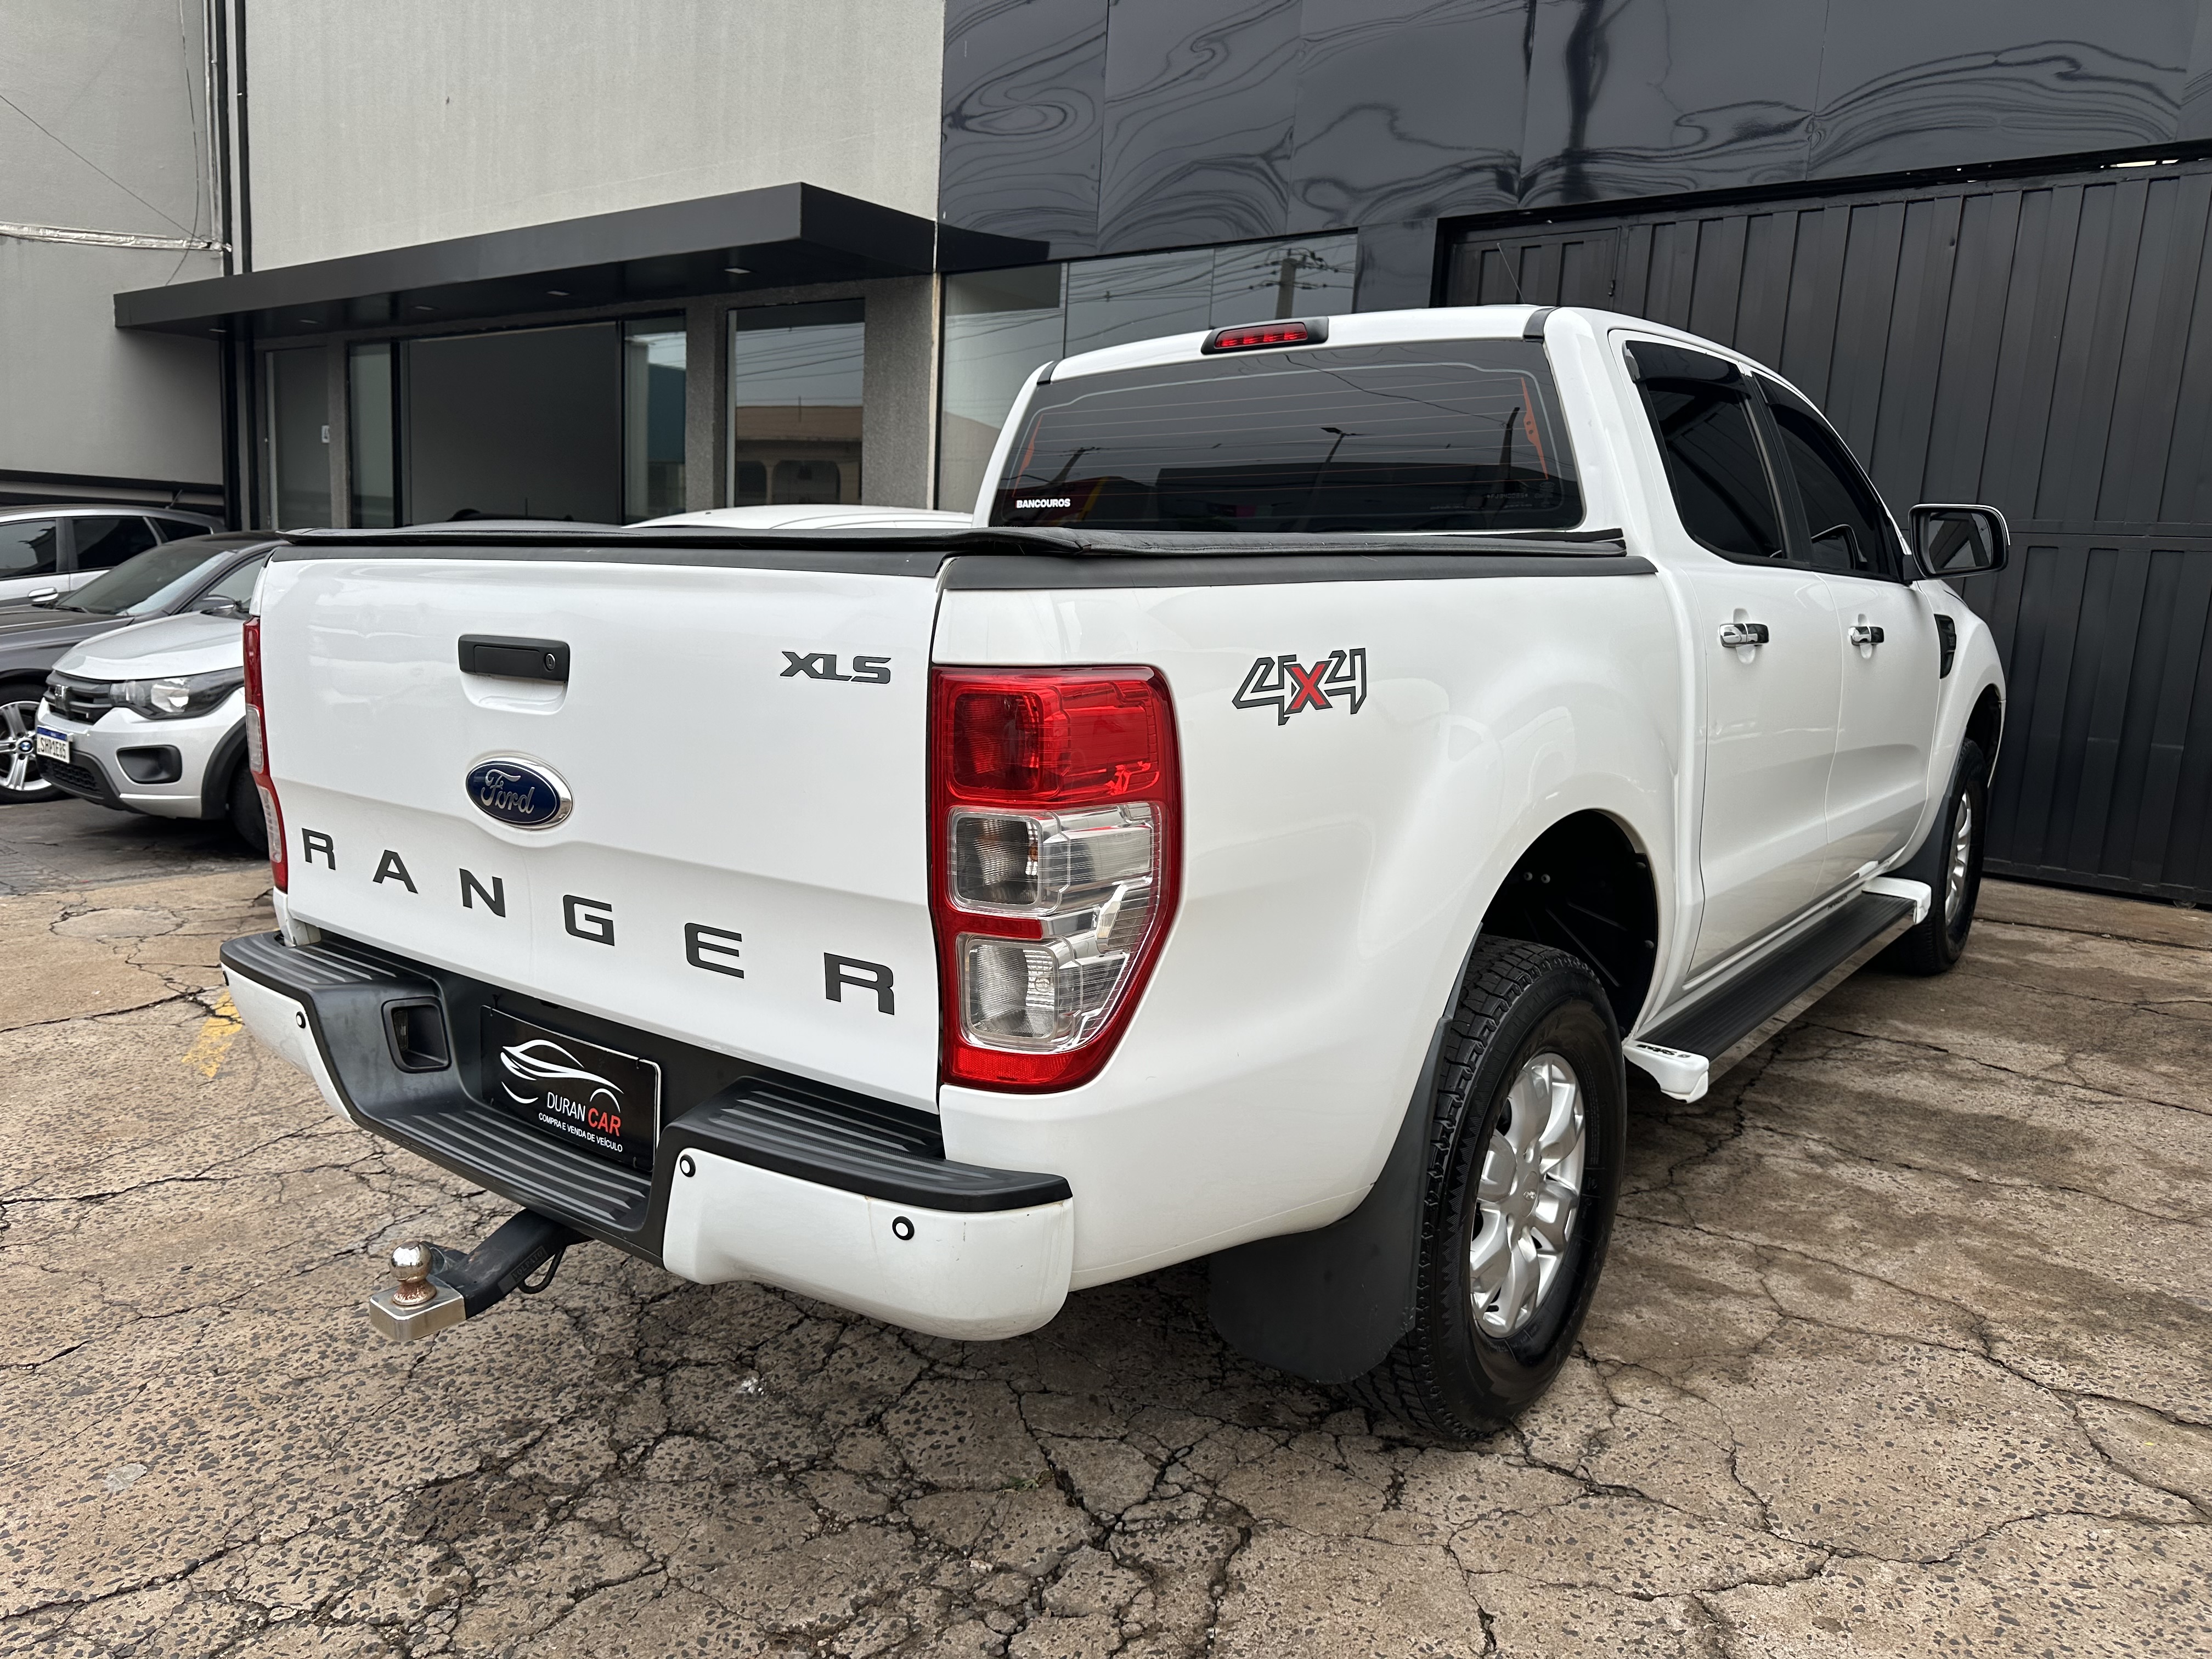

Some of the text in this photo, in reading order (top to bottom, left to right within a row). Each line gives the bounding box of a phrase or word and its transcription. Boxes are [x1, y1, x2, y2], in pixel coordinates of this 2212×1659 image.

[1016, 498, 1071, 509] BANCOUROS
[780, 651, 891, 684] XLS
[480, 769, 535, 814] Ford
[301, 827, 895, 1016] RANGER
[538, 1112, 623, 1152] COMPRA E VENDA DE VEÍCULO
[546, 1091, 621, 1137] DURAN CAR
